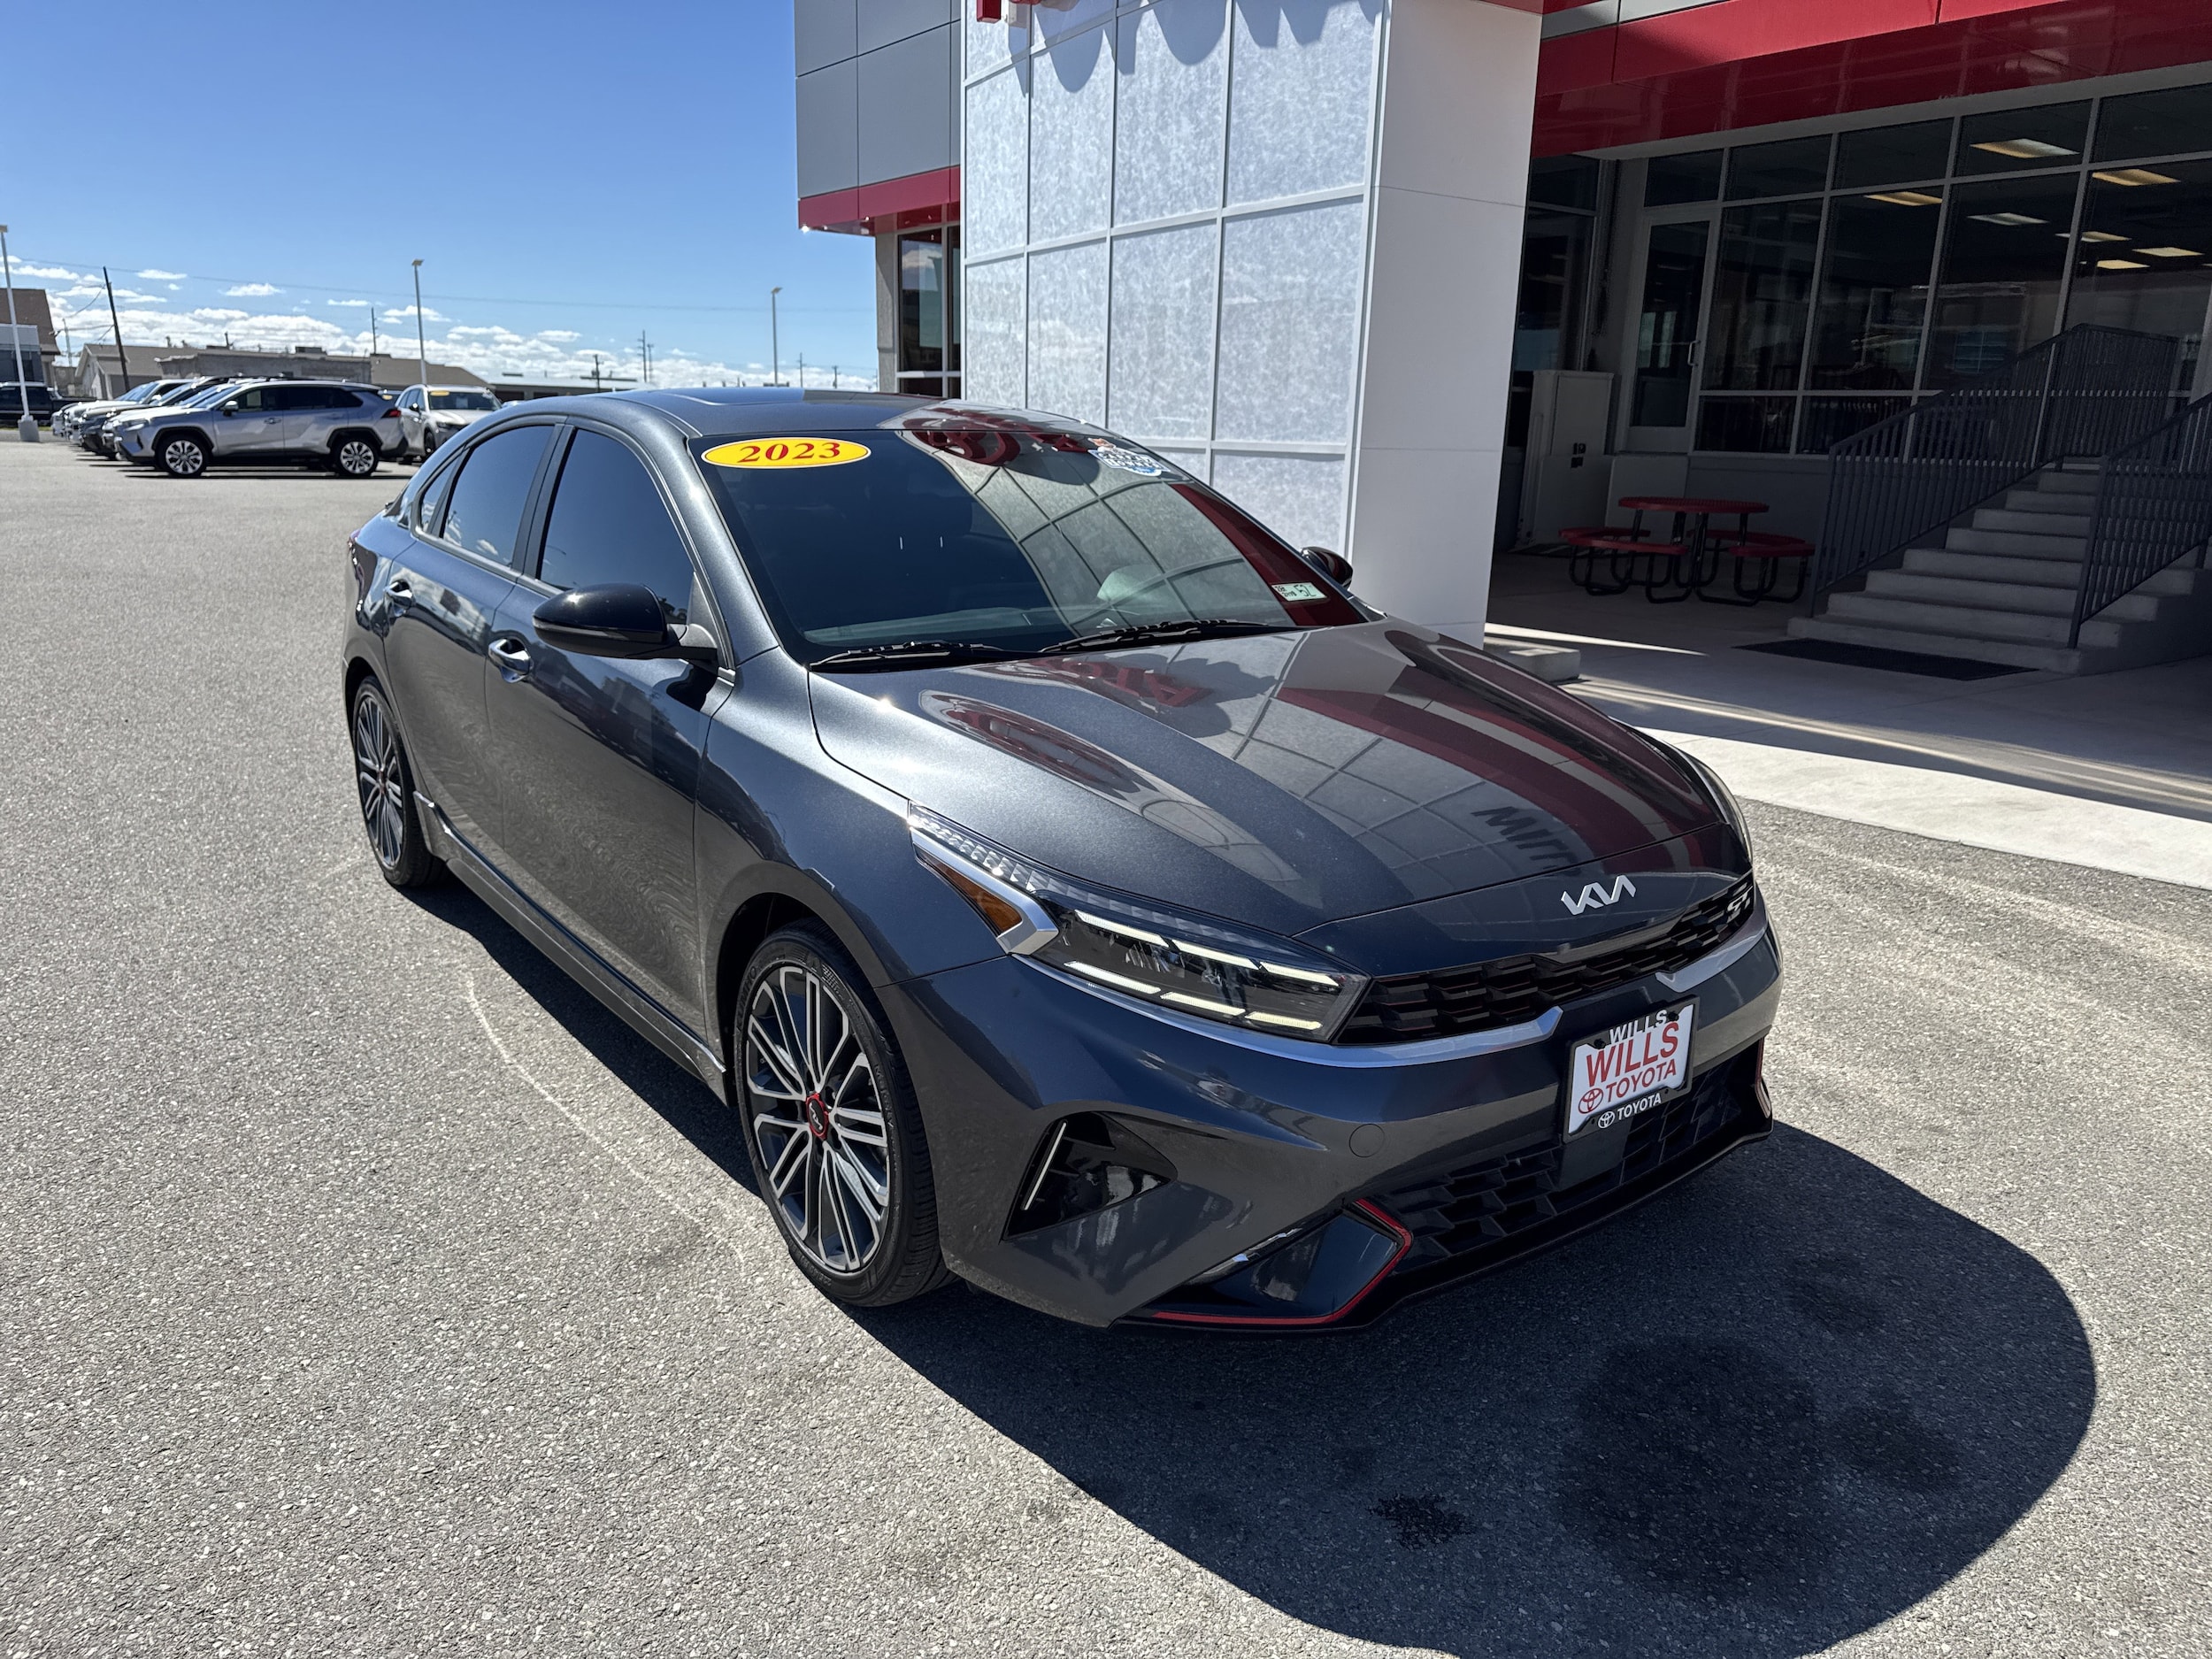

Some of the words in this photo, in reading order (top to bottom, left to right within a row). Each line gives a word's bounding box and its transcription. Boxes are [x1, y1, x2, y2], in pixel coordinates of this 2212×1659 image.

[737, 442, 841, 464] 2023
[1561, 874, 1637, 916] KIA
[1609, 1010, 1667, 1045] WILLS
[1586, 1022, 1679, 1087] WILLS
[1606, 1058, 1677, 1102] TOYOTA
[1617, 1093, 1662, 1120] TOYOTA
